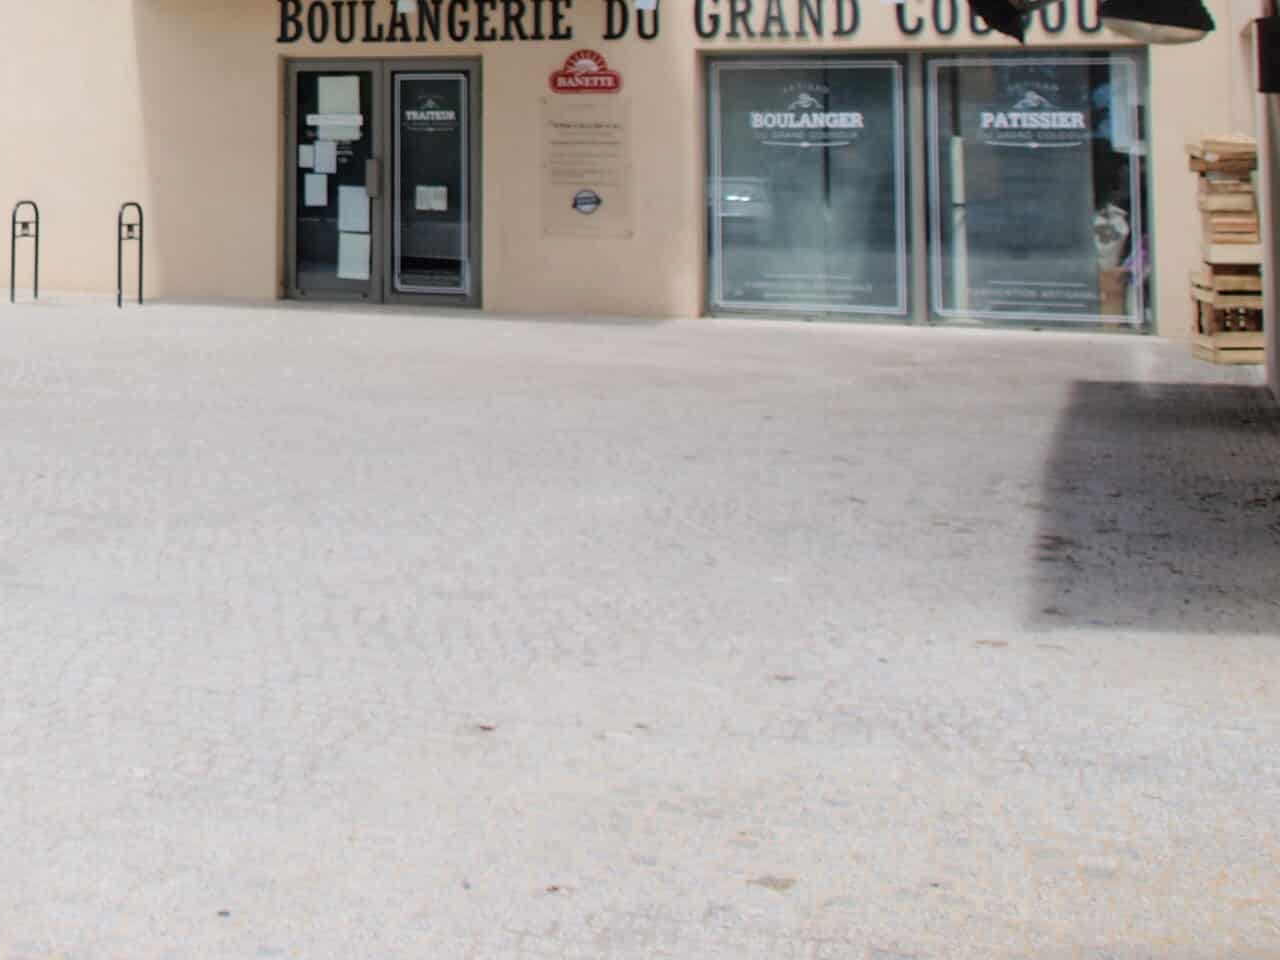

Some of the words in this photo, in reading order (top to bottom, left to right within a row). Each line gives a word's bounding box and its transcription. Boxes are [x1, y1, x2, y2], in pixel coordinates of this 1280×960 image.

[404, 110, 457, 121] TRAITEUR
[751, 111, 865, 129] BOULANGER
[981, 111, 1086, 129] PATISSIER
